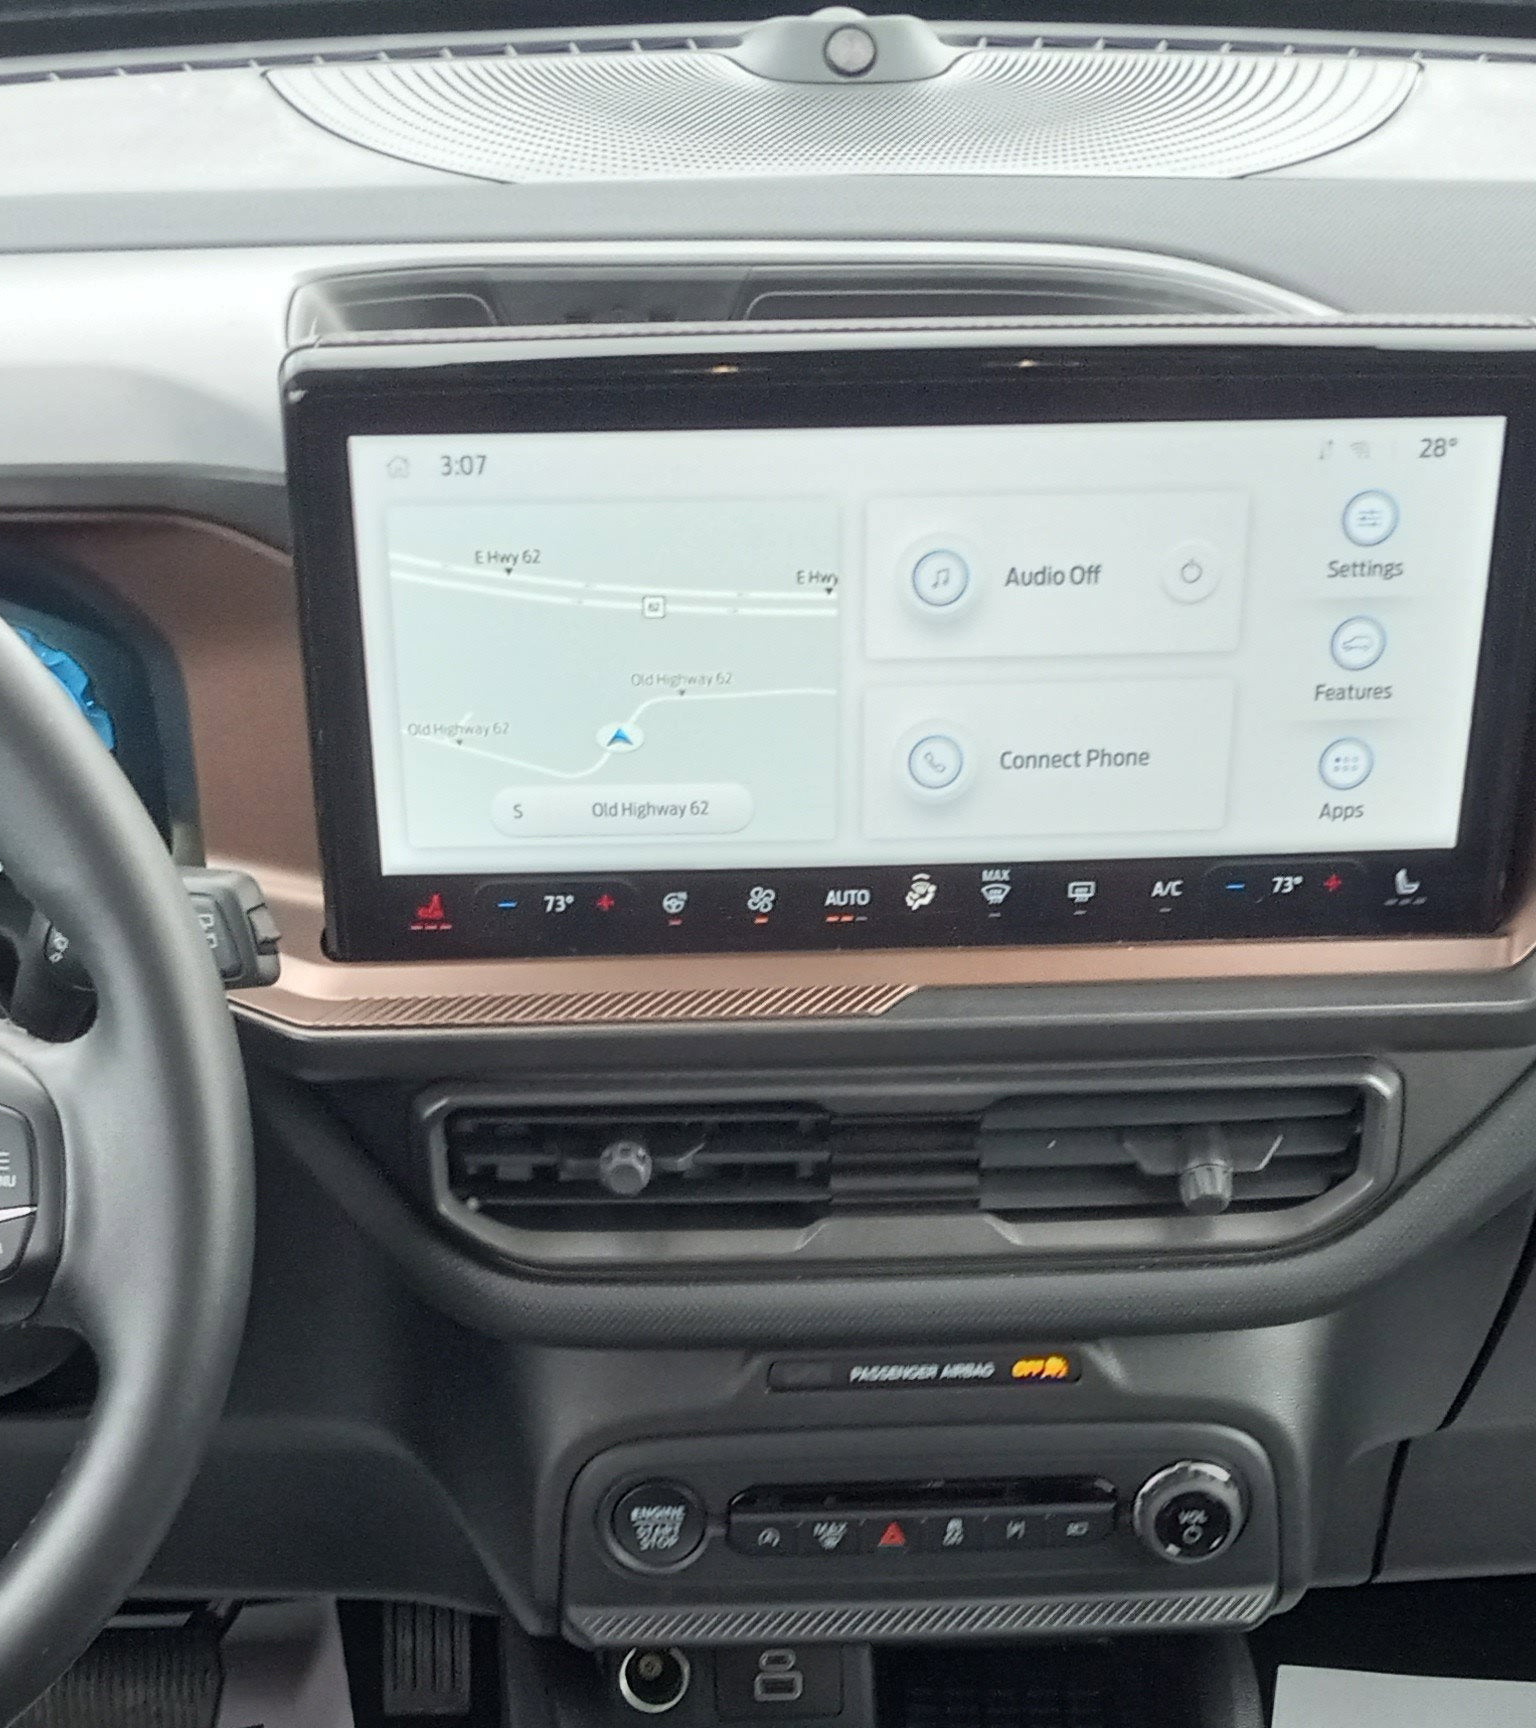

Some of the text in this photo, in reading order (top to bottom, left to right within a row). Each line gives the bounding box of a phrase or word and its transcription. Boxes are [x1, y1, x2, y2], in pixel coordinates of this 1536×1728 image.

[1419, 436, 1458, 459] 28°
[440, 455, 488, 477] 3:07
[475, 549, 542, 567] E Hwy 62
[796, 571, 805, 584] E
[1004, 564, 1102, 588] Audio Off
[1326, 558, 1404, 581] Settings
[631, 671, 733, 690] Old Highway 62
[1314, 681, 1392, 703] Features
[407, 721, 510, 740] Old Highway 62
[999, 746, 1150, 771] Connect Phone
[512, 800, 710, 823] S Old Highway 62
[1319, 800, 1364, 823] Apps
[982, 869, 1010, 882] MAX
[825, 888, 871, 907] AUTO
[1152, 879, 1183, 897] A/C
[850, 1364, 939, 1382] PASSENGER
[940, 1361, 996, 1380] AIRBAG
